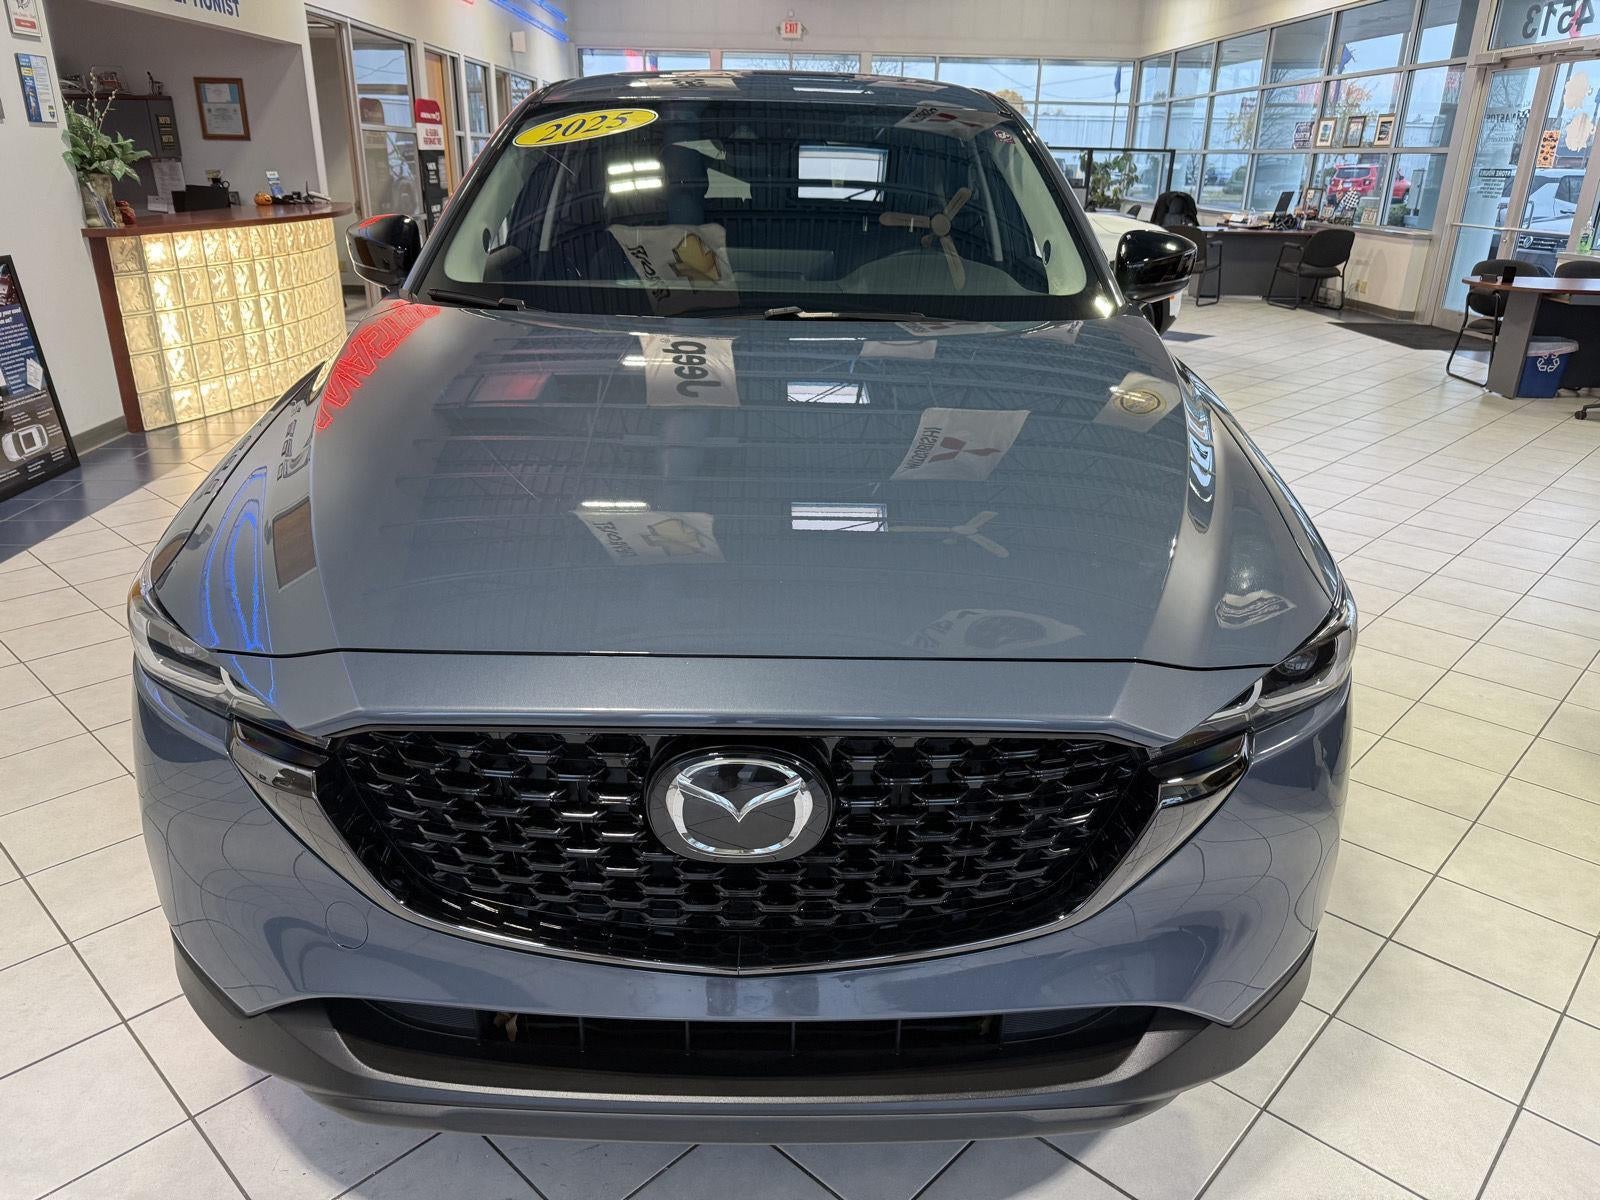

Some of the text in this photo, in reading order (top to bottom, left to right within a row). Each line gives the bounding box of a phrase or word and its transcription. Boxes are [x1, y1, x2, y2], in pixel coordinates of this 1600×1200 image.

[174, 0, 240, 17] IONIST
[784, 22, 799, 34] EXIT
[536, 111, 634, 143] 2025
